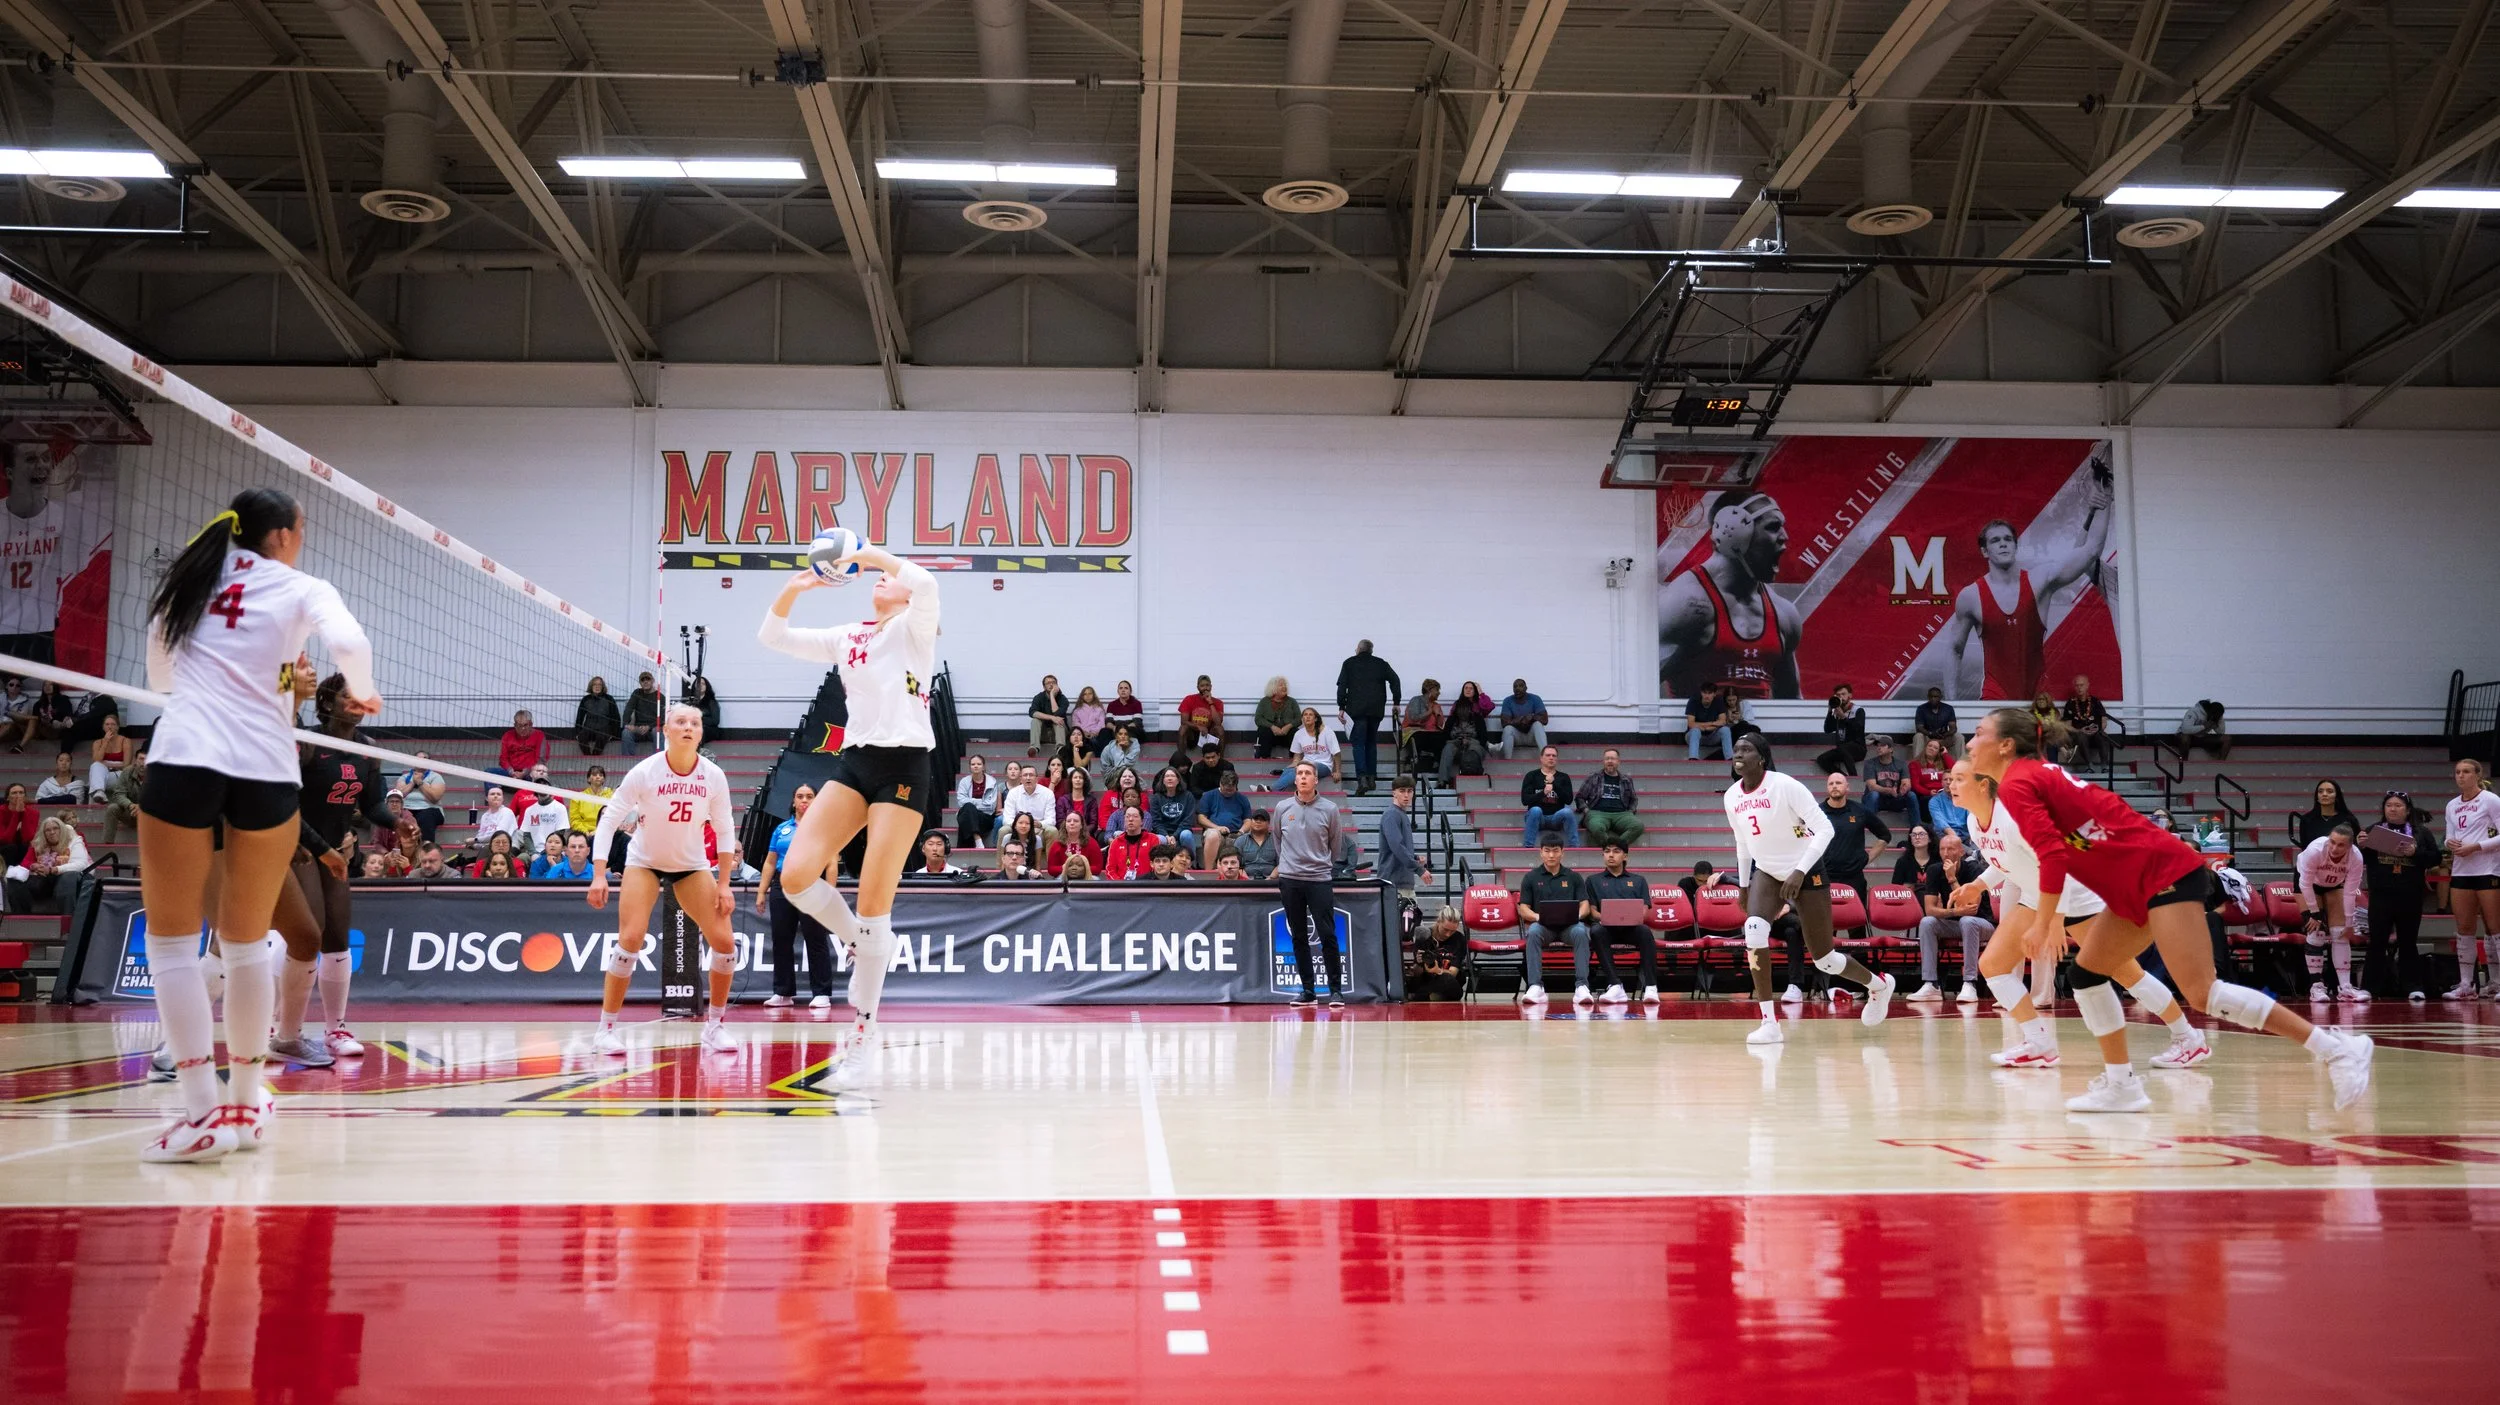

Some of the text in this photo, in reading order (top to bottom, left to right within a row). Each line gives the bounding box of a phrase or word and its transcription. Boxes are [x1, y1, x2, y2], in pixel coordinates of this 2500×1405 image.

[1706, 400, 1741, 409] 1:30
[658, 451, 1133, 547] MARYLAND
[1799, 451, 1906, 569] WRESTLING
[10, 561, 33, 589] 12
[1889, 536, 1949, 596] M
[208, 583, 245, 629] 4
[1877, 614, 1944, 690] MARYLAND
[341, 764, 357, 780] R
[327, 781, 363, 804] 22
[657, 783, 706, 797] MARYLAND
[668, 801, 693, 822] 26
[1734, 798, 1771, 814] MARYLAND
[1748, 815, 1761, 835] 3
[2325, 875, 2338, 884] 10
[1470, 889, 1508, 899] MARYLAND
[1650, 889, 1682, 898] ARYLAND
[1702, 889, 1740, 899] MARYLAND
[1874, 890, 1912, 899] MARYLAND
[675, 909, 685, 973] sports imports
[983, 932, 1238, 973] CHALLENGE
